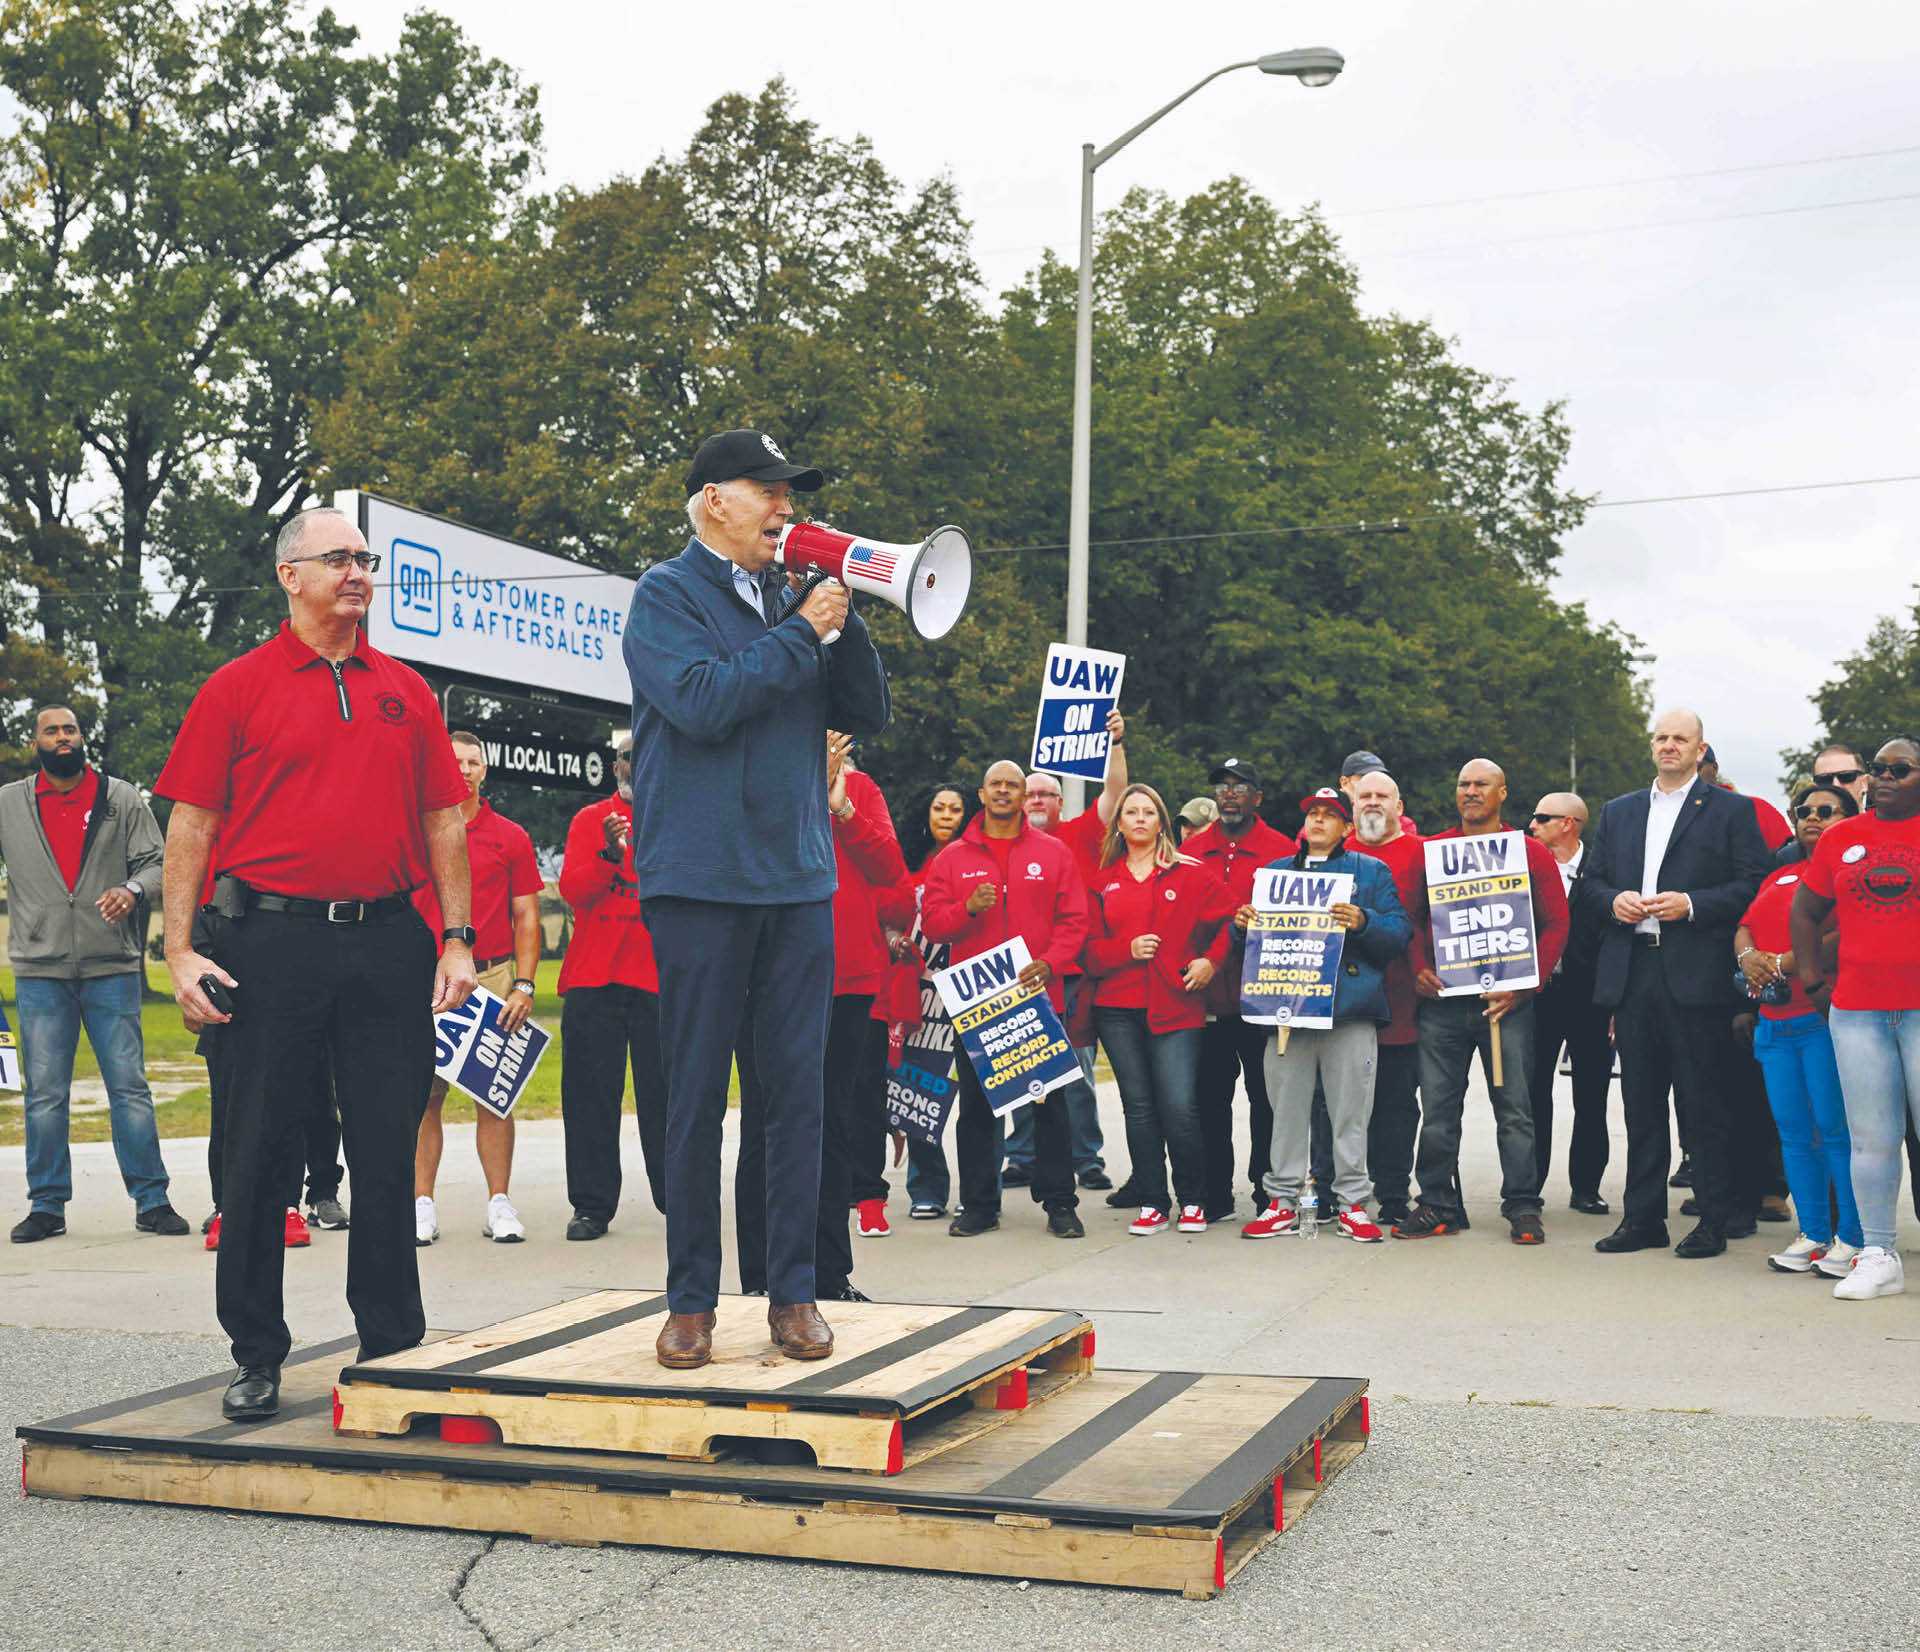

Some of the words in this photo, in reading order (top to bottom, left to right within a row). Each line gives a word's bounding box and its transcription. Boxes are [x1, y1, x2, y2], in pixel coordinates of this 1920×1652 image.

[400, 563, 432, 613] gm
[451, 569, 565, 621] CUSTOMER
[575, 601, 622, 636] CARE
[452, 602, 465, 629] &
[473, 608, 605, 662] AFTERSALES
[1050, 655, 1119, 695] UAW
[1063, 703, 1094, 733] ON
[505, 744, 555, 775] LOCAL
[558, 752, 581, 778] 174
[1037, 731, 1108, 764] STRIKE
[1441, 838, 1508, 876] UAW
[1269, 875, 1336, 907] UAW
[1435, 881, 1493, 901] STAND
[1498, 878, 1522, 890] UP
[1255, 914, 1310, 929] STAND
[1317, 917, 1340, 929] UP
[1449, 903, 1514, 934] END
[1259, 952, 1324, 967] PROFITS
[1262, 938, 1326, 953] RECORD
[1438, 927, 1529, 961] TIERS
[950, 948, 1016, 1001] UAW
[1244, 982, 1332, 997] CONTRACTS
[1258, 968, 1321, 982] RECORD
[959, 995, 1013, 1029] STAND
[978, 1007, 1038, 1043] RECORD
[475, 1027, 505, 1069] ON
[983, 1020, 1044, 1057] PROFITS
[991, 1034, 1049, 1072] RECORD
[984, 1039, 1069, 1089] CONTRACTS
[887, 1079, 941, 1118] RONG
[887, 1097, 938, 1131] TRACT
